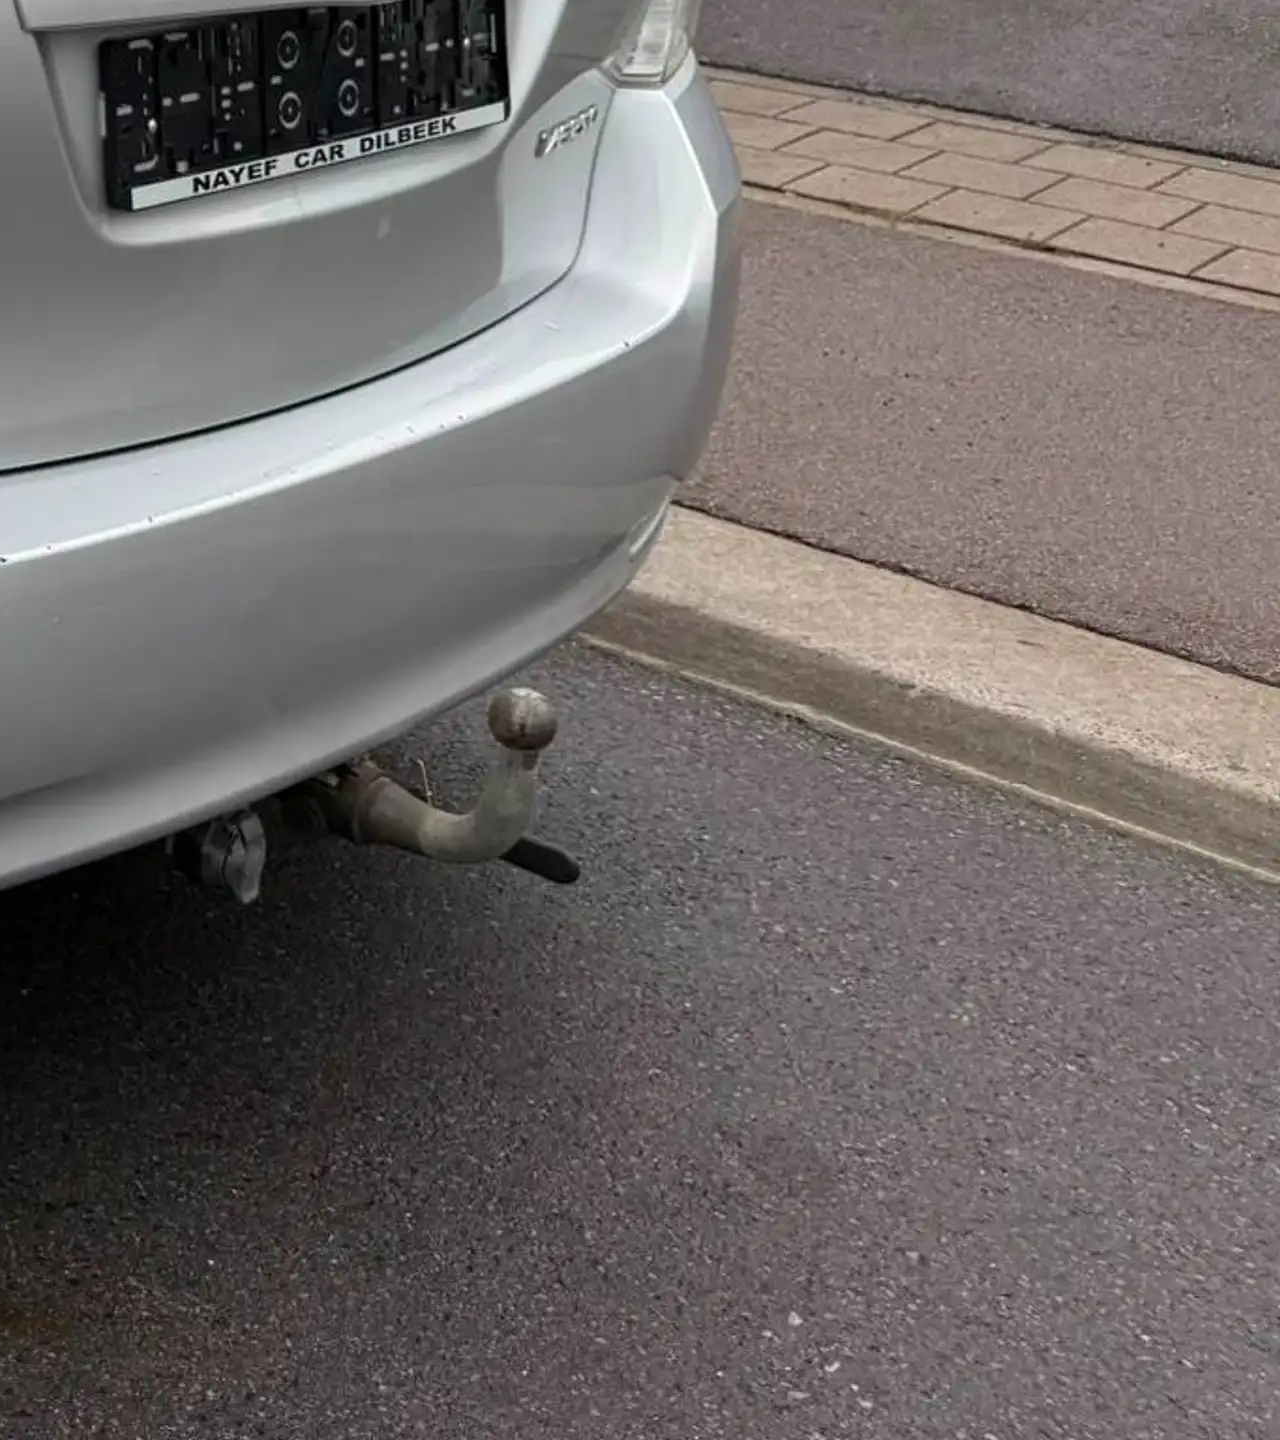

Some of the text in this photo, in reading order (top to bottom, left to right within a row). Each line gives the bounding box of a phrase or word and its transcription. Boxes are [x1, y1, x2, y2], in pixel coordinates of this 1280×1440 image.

[192, 116, 458, 194] NAYEF CAR DILBEEK
